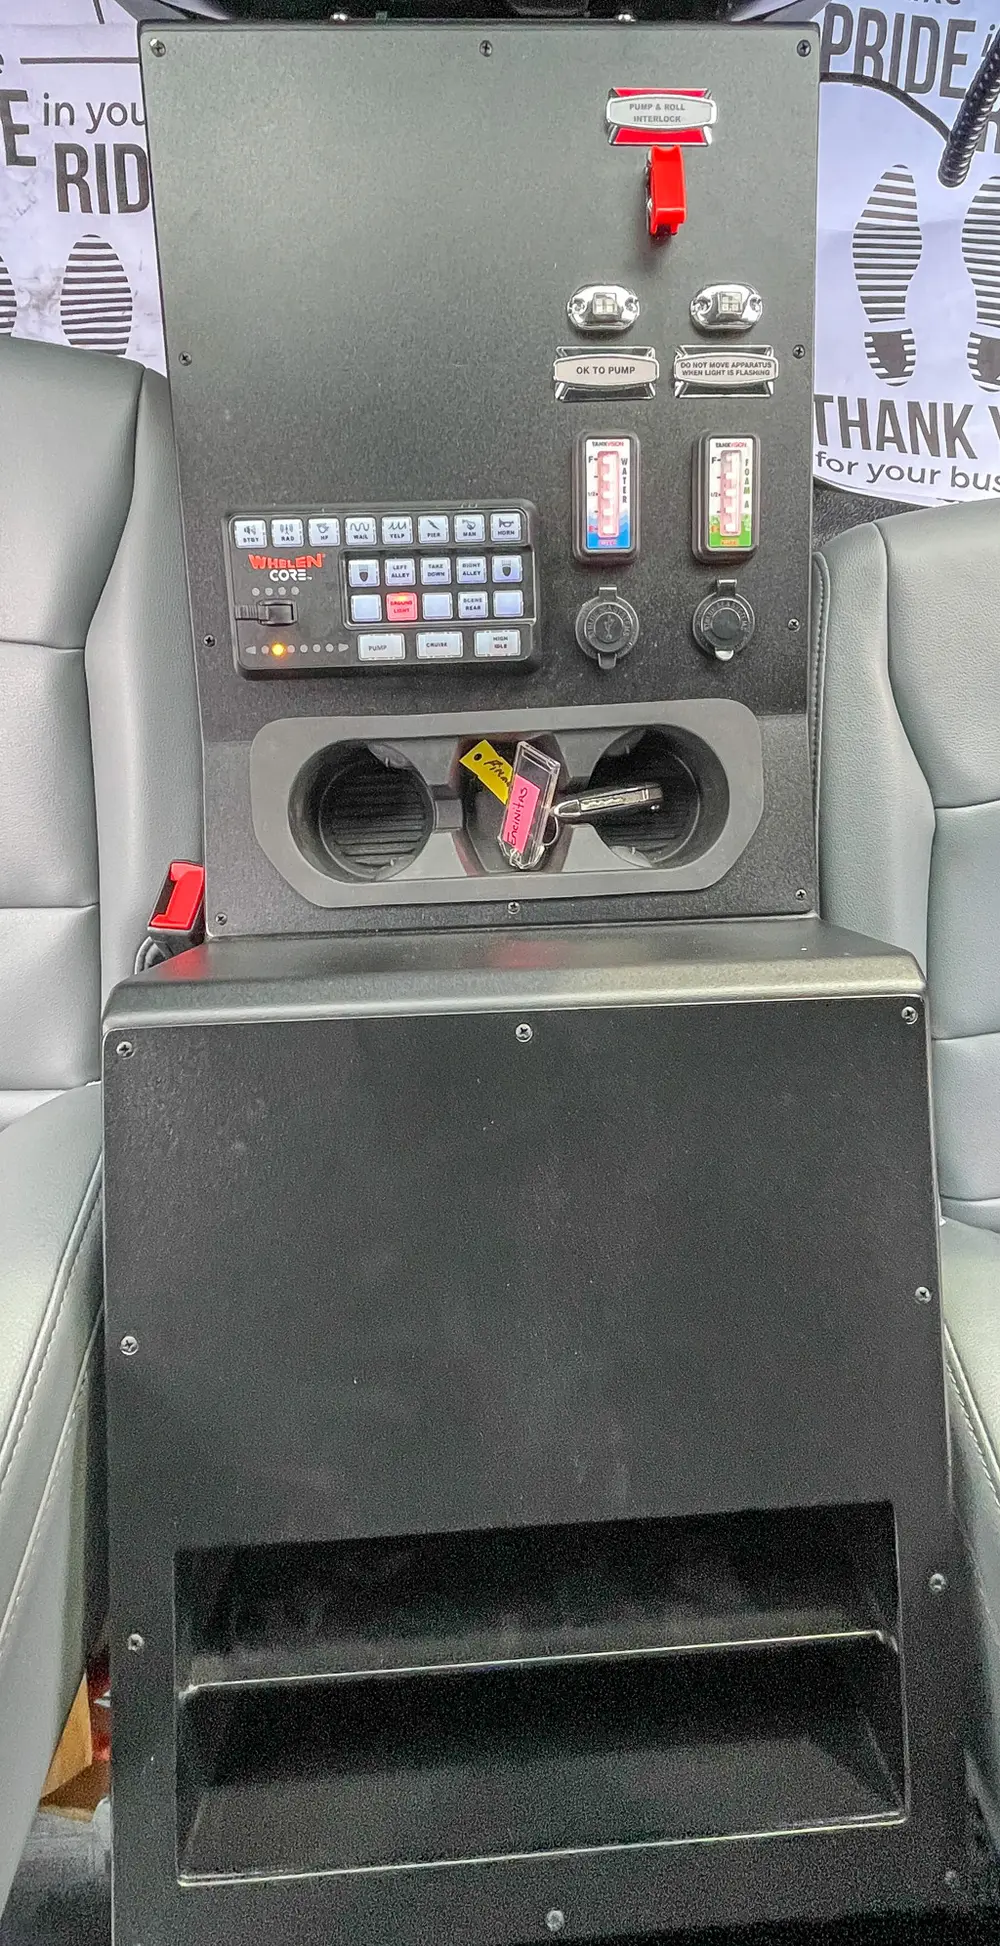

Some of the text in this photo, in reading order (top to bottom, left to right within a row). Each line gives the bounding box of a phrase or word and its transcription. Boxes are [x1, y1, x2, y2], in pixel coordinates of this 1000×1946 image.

[820, 2, 976, 100] PRIDE
[43, 91, 76, 127] in
[629, 103, 687, 111] PUMP & ROLL
[633, 115, 682, 123] INTERLOCK
[54, 142, 150, 214] RID
[575, 365, 636, 375] OK TO PUMP
[680, 361, 772, 369] DO NOT MOVE APPARATUS
[681, 369, 771, 377] WHEN LIGHT IS FLASHING
[813, 394, 978, 460] THANK
[815, 451, 860, 476] for
[866, 462, 942, 485] your
[620, 456, 629, 505] WATER
[367, 644, 388, 652] PUMP
